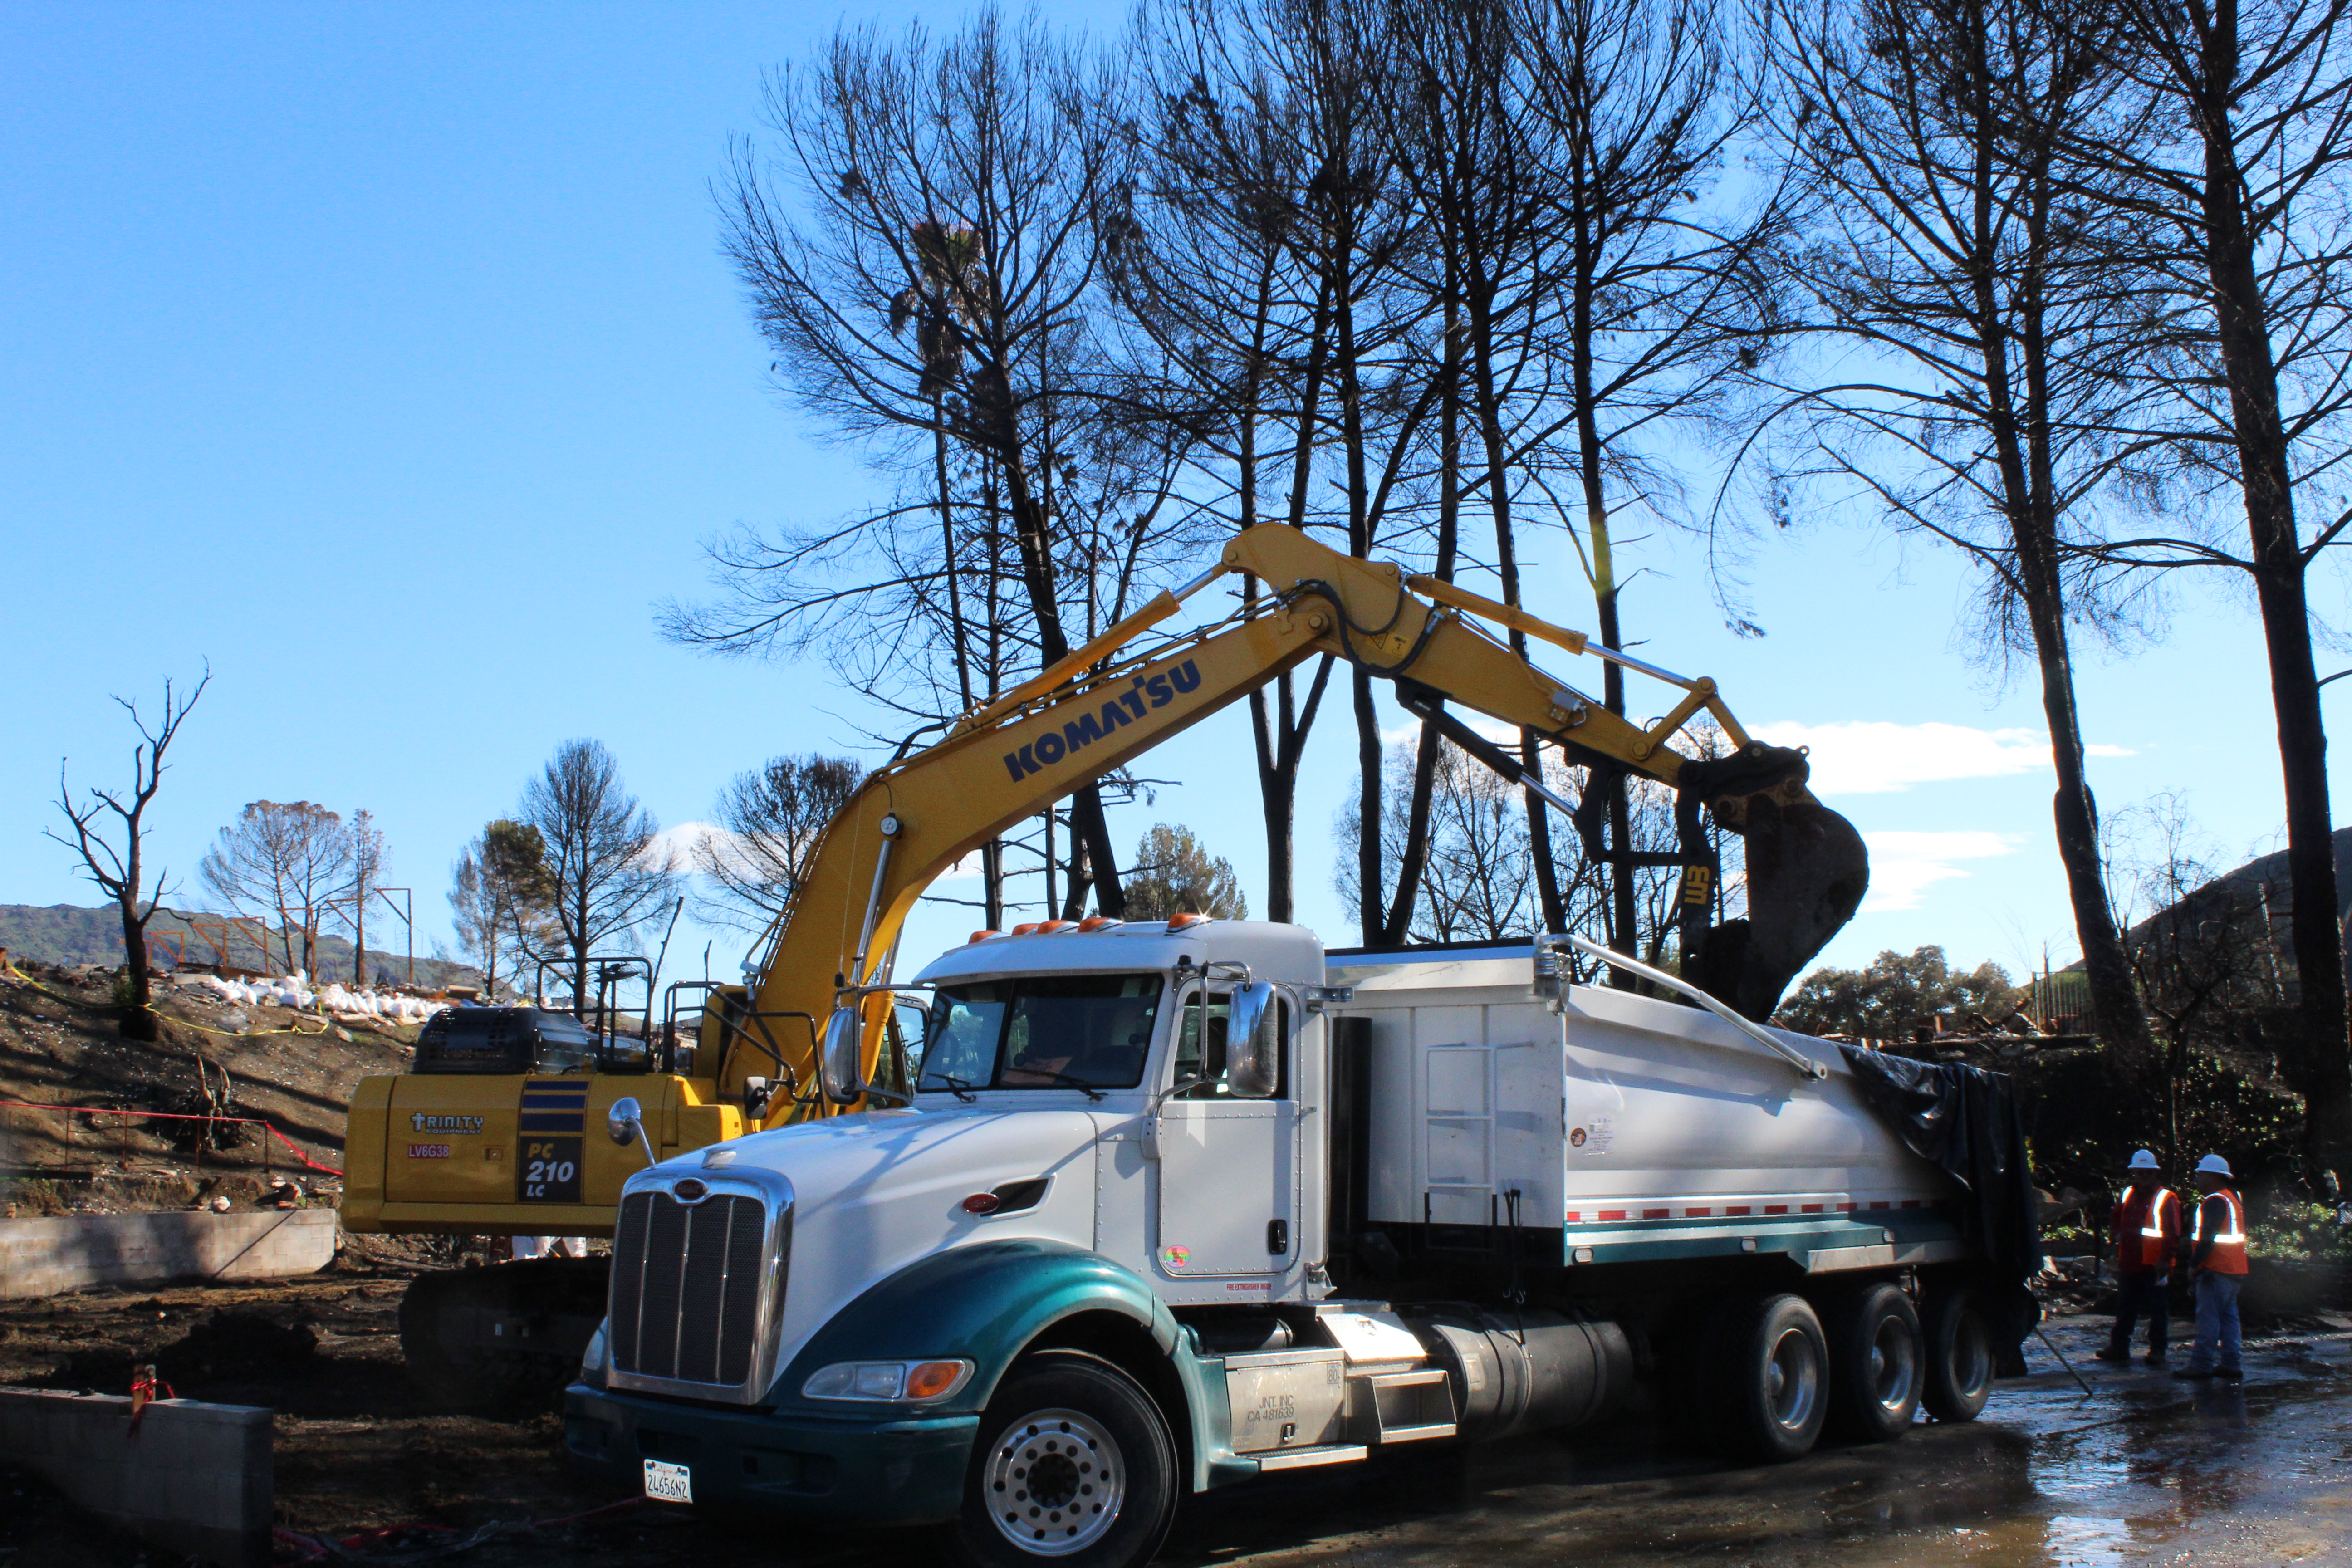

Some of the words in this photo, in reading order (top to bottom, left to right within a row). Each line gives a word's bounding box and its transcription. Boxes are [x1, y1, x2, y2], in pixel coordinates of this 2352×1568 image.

[1003, 659, 1201, 783] KOMATSU
[411, 1112, 484, 1132] TRINITY
[409, 1145, 449, 1157] LV6G38
[527, 1143, 554, 1158] PC
[526, 1161, 574, 1182] 210
[526, 1184, 546, 1196] LC
[1328, 1368, 1338, 1382] 80
[1279, 1394, 1294, 1407] INC
[1247, 1410, 1260, 1421] CA
[647, 1474, 688, 1499] 24656N2
